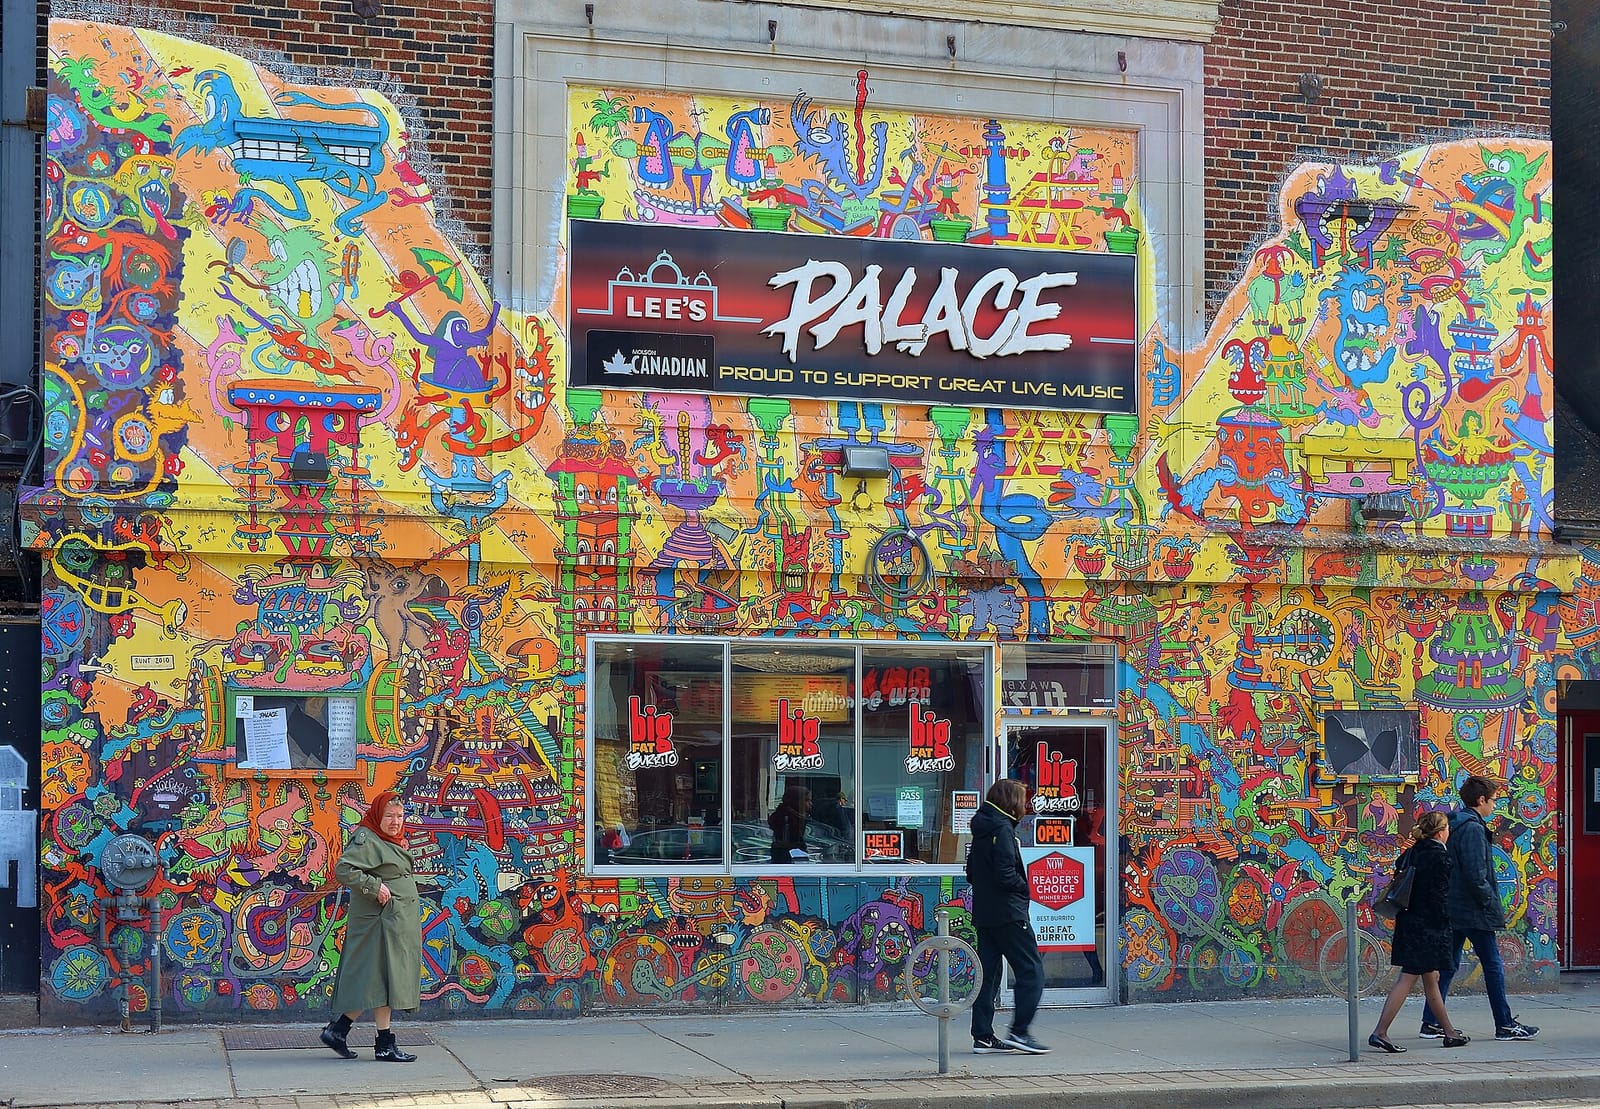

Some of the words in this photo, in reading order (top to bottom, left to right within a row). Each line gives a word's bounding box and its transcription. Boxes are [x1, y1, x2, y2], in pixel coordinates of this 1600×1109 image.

[626, 296, 707, 321] LEE'S
[760, 258, 1078, 363] PALACE
[719, 366, 794, 383] PROUD
[800, 370, 828, 384] TO
[834, 372, 932, 390] SUPPORT
[938, 377, 1006, 393] GREAT
[1012, 381, 1057, 396] LIVE
[1062, 384, 1124, 399] MUSIC
[630, 697, 671, 753] big
[780, 700, 819, 755] big
[911, 703, 949, 758] big
[632, 743, 655, 752] FAT
[780, 745, 802, 755] FAT
[911, 747, 933, 757] FAT
[627, 751, 677, 768] BURRITO
[774, 754, 823, 769] BURRITO
[906, 756, 953, 771] BURRITO
[1039, 743, 1075, 798] big
[901, 791, 920, 800] PASS
[1038, 787, 1059, 797] FAT
[1033, 796, 1078, 810] BURRITO
[866, 834, 899, 847] HELP
[1037, 825, 1070, 842] OPEN
[1046, 857, 1064, 869] NOW
[1032, 875, 1079, 885] READER'S
[1036, 885, 1075, 893] CHOICE
[1040, 926, 1055, 934] BIG
[1057, 926, 1073, 934] FAT
[1036, 934, 1076, 942] BURRITO
